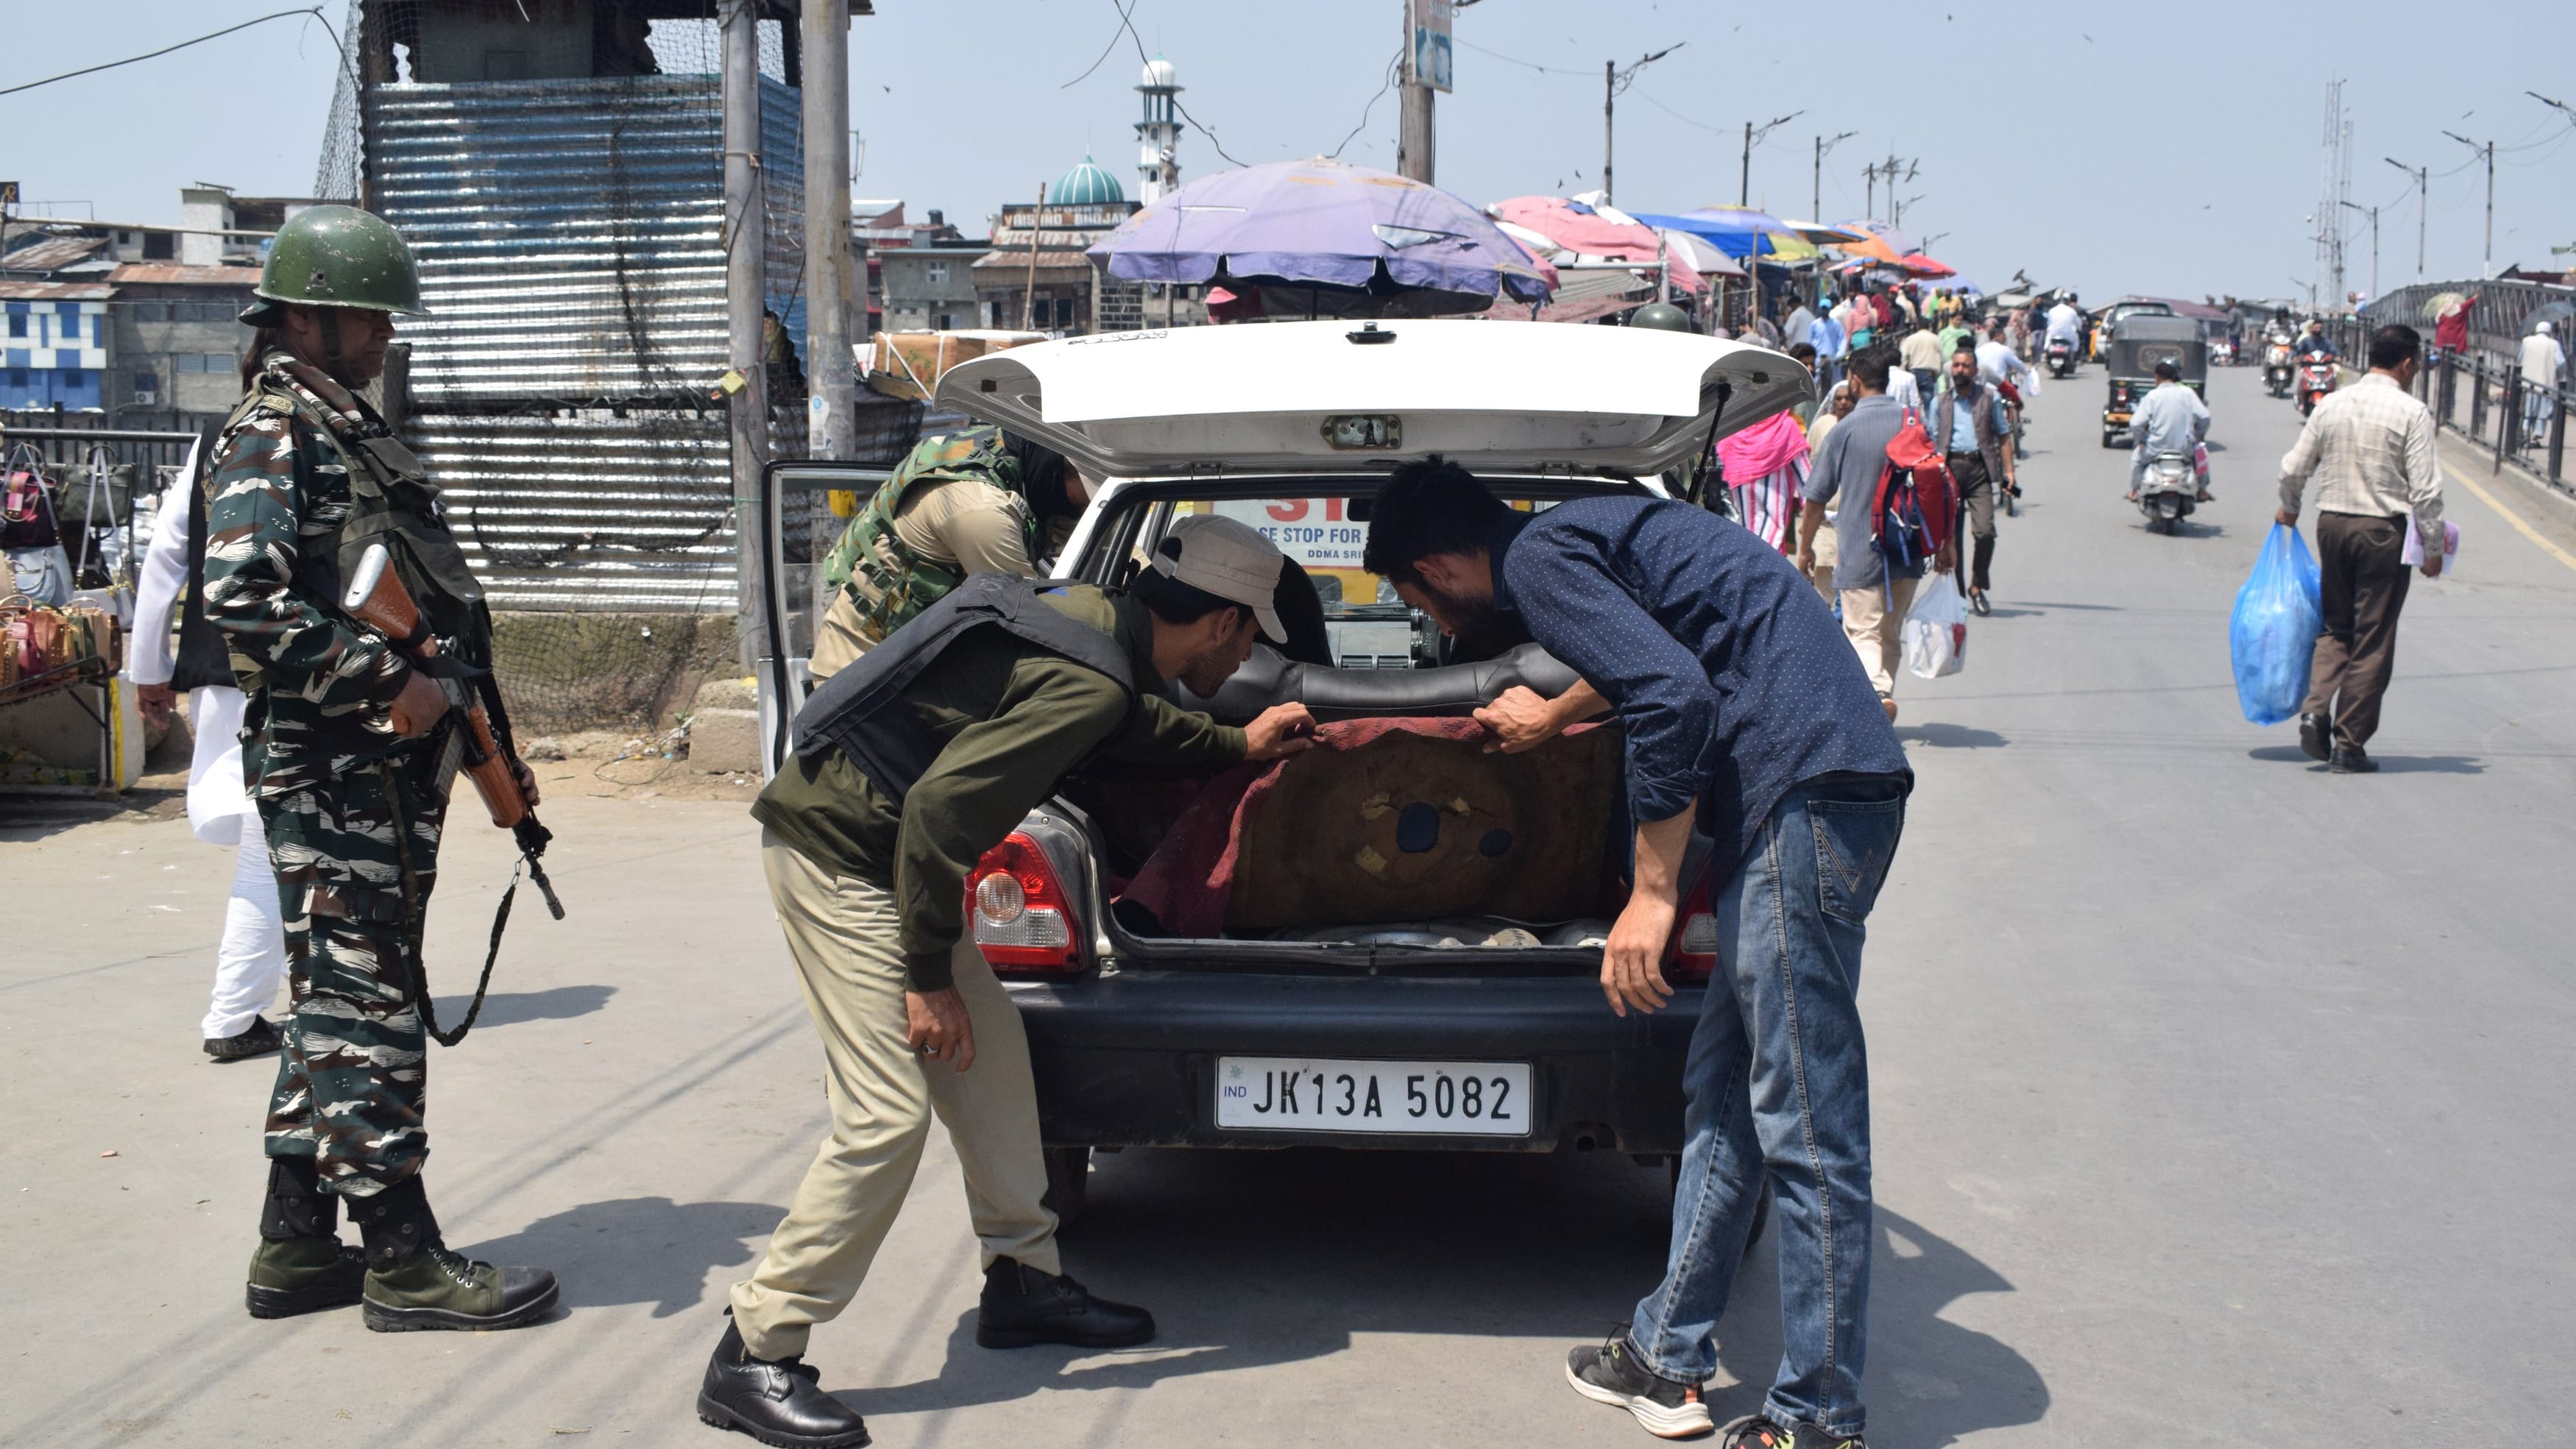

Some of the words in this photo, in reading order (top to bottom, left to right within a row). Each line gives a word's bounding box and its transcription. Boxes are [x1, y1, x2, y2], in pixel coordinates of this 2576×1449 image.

[1283, 527, 1324, 543] STOP
[1330, 528, 1361, 543] FOR
[1308, 550, 1340, 559] DDMA
[1224, 1085, 1247, 1098] IND
[1406, 1074, 1511, 1120] 5082
